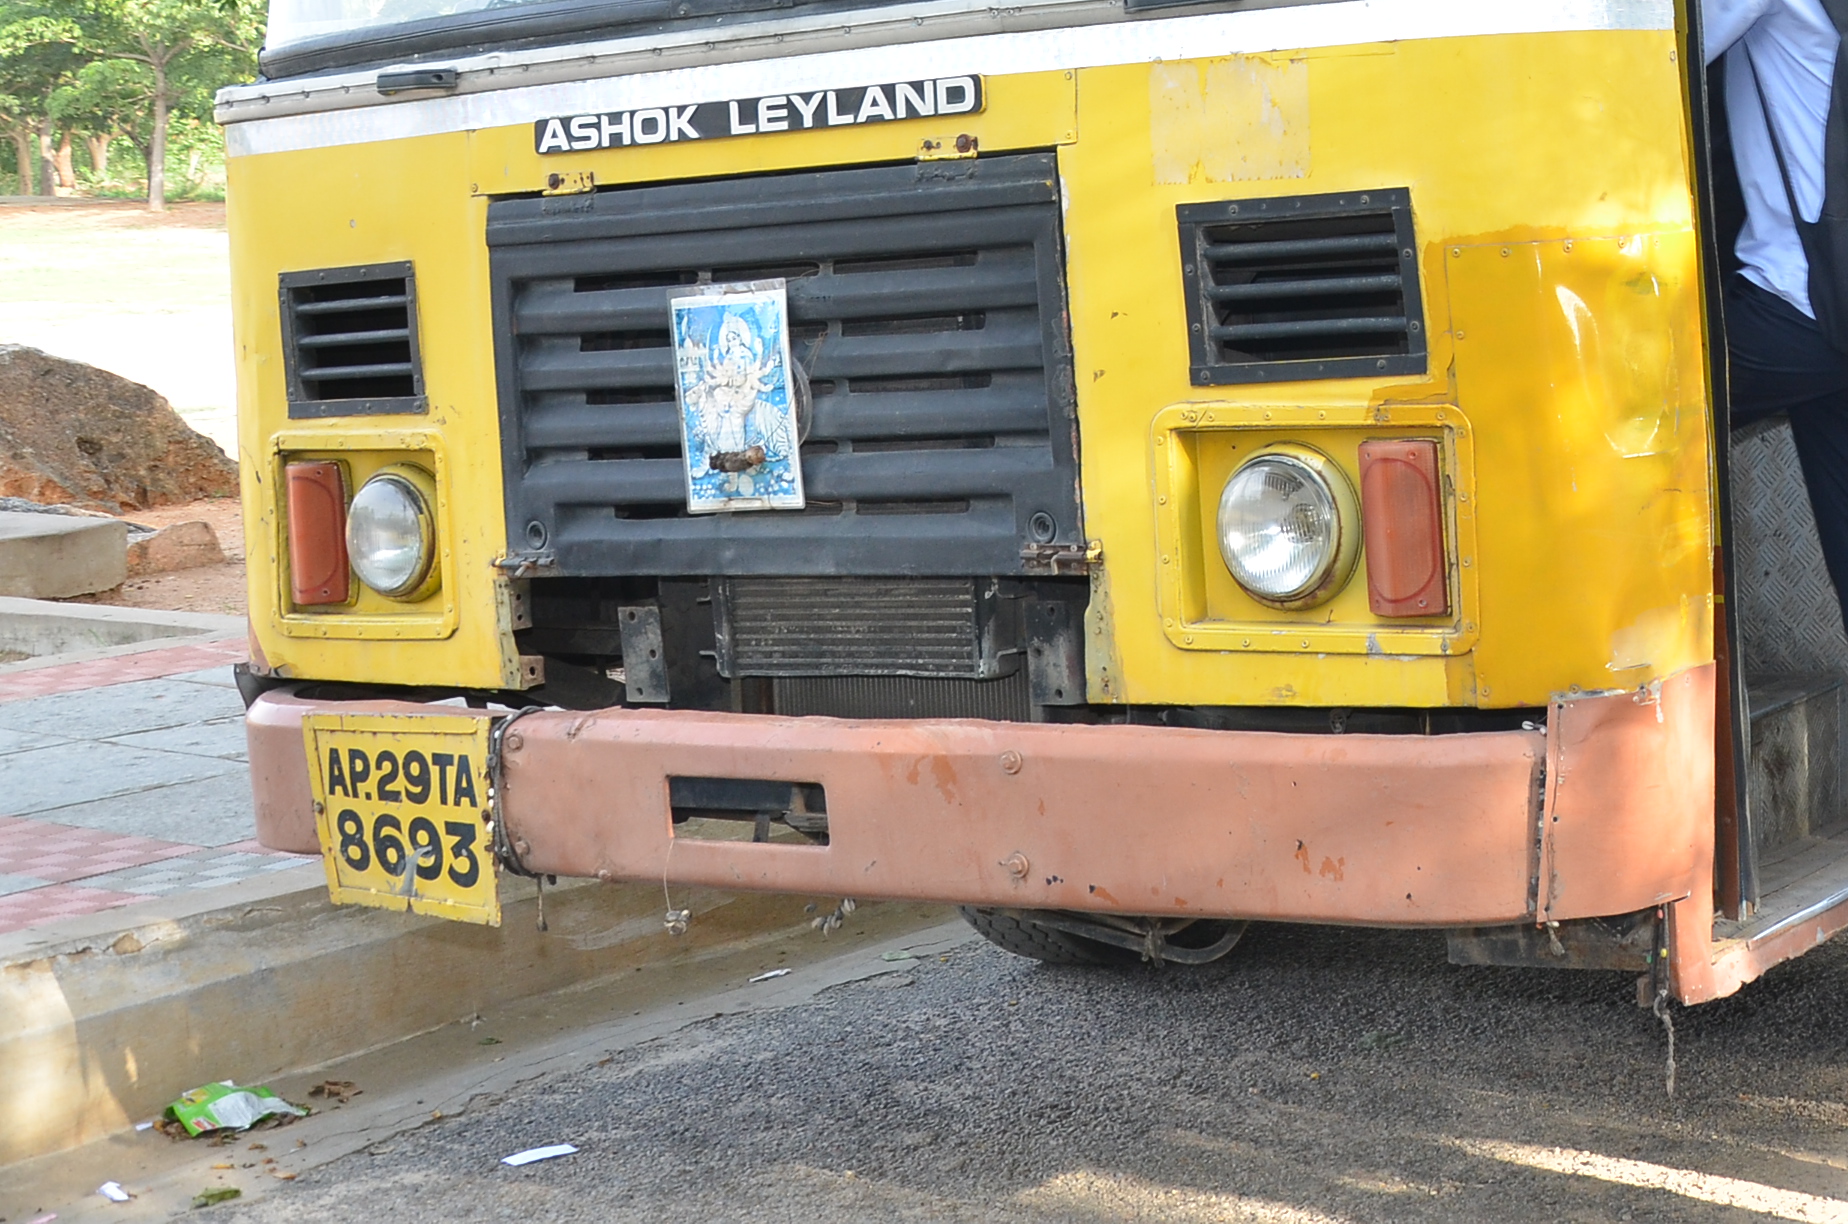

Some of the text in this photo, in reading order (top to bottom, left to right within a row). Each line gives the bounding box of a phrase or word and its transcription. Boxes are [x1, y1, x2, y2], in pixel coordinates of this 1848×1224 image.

[538, 75, 976, 154] ASHOK LEYLAND
[336, 808, 480, 888] 8693
